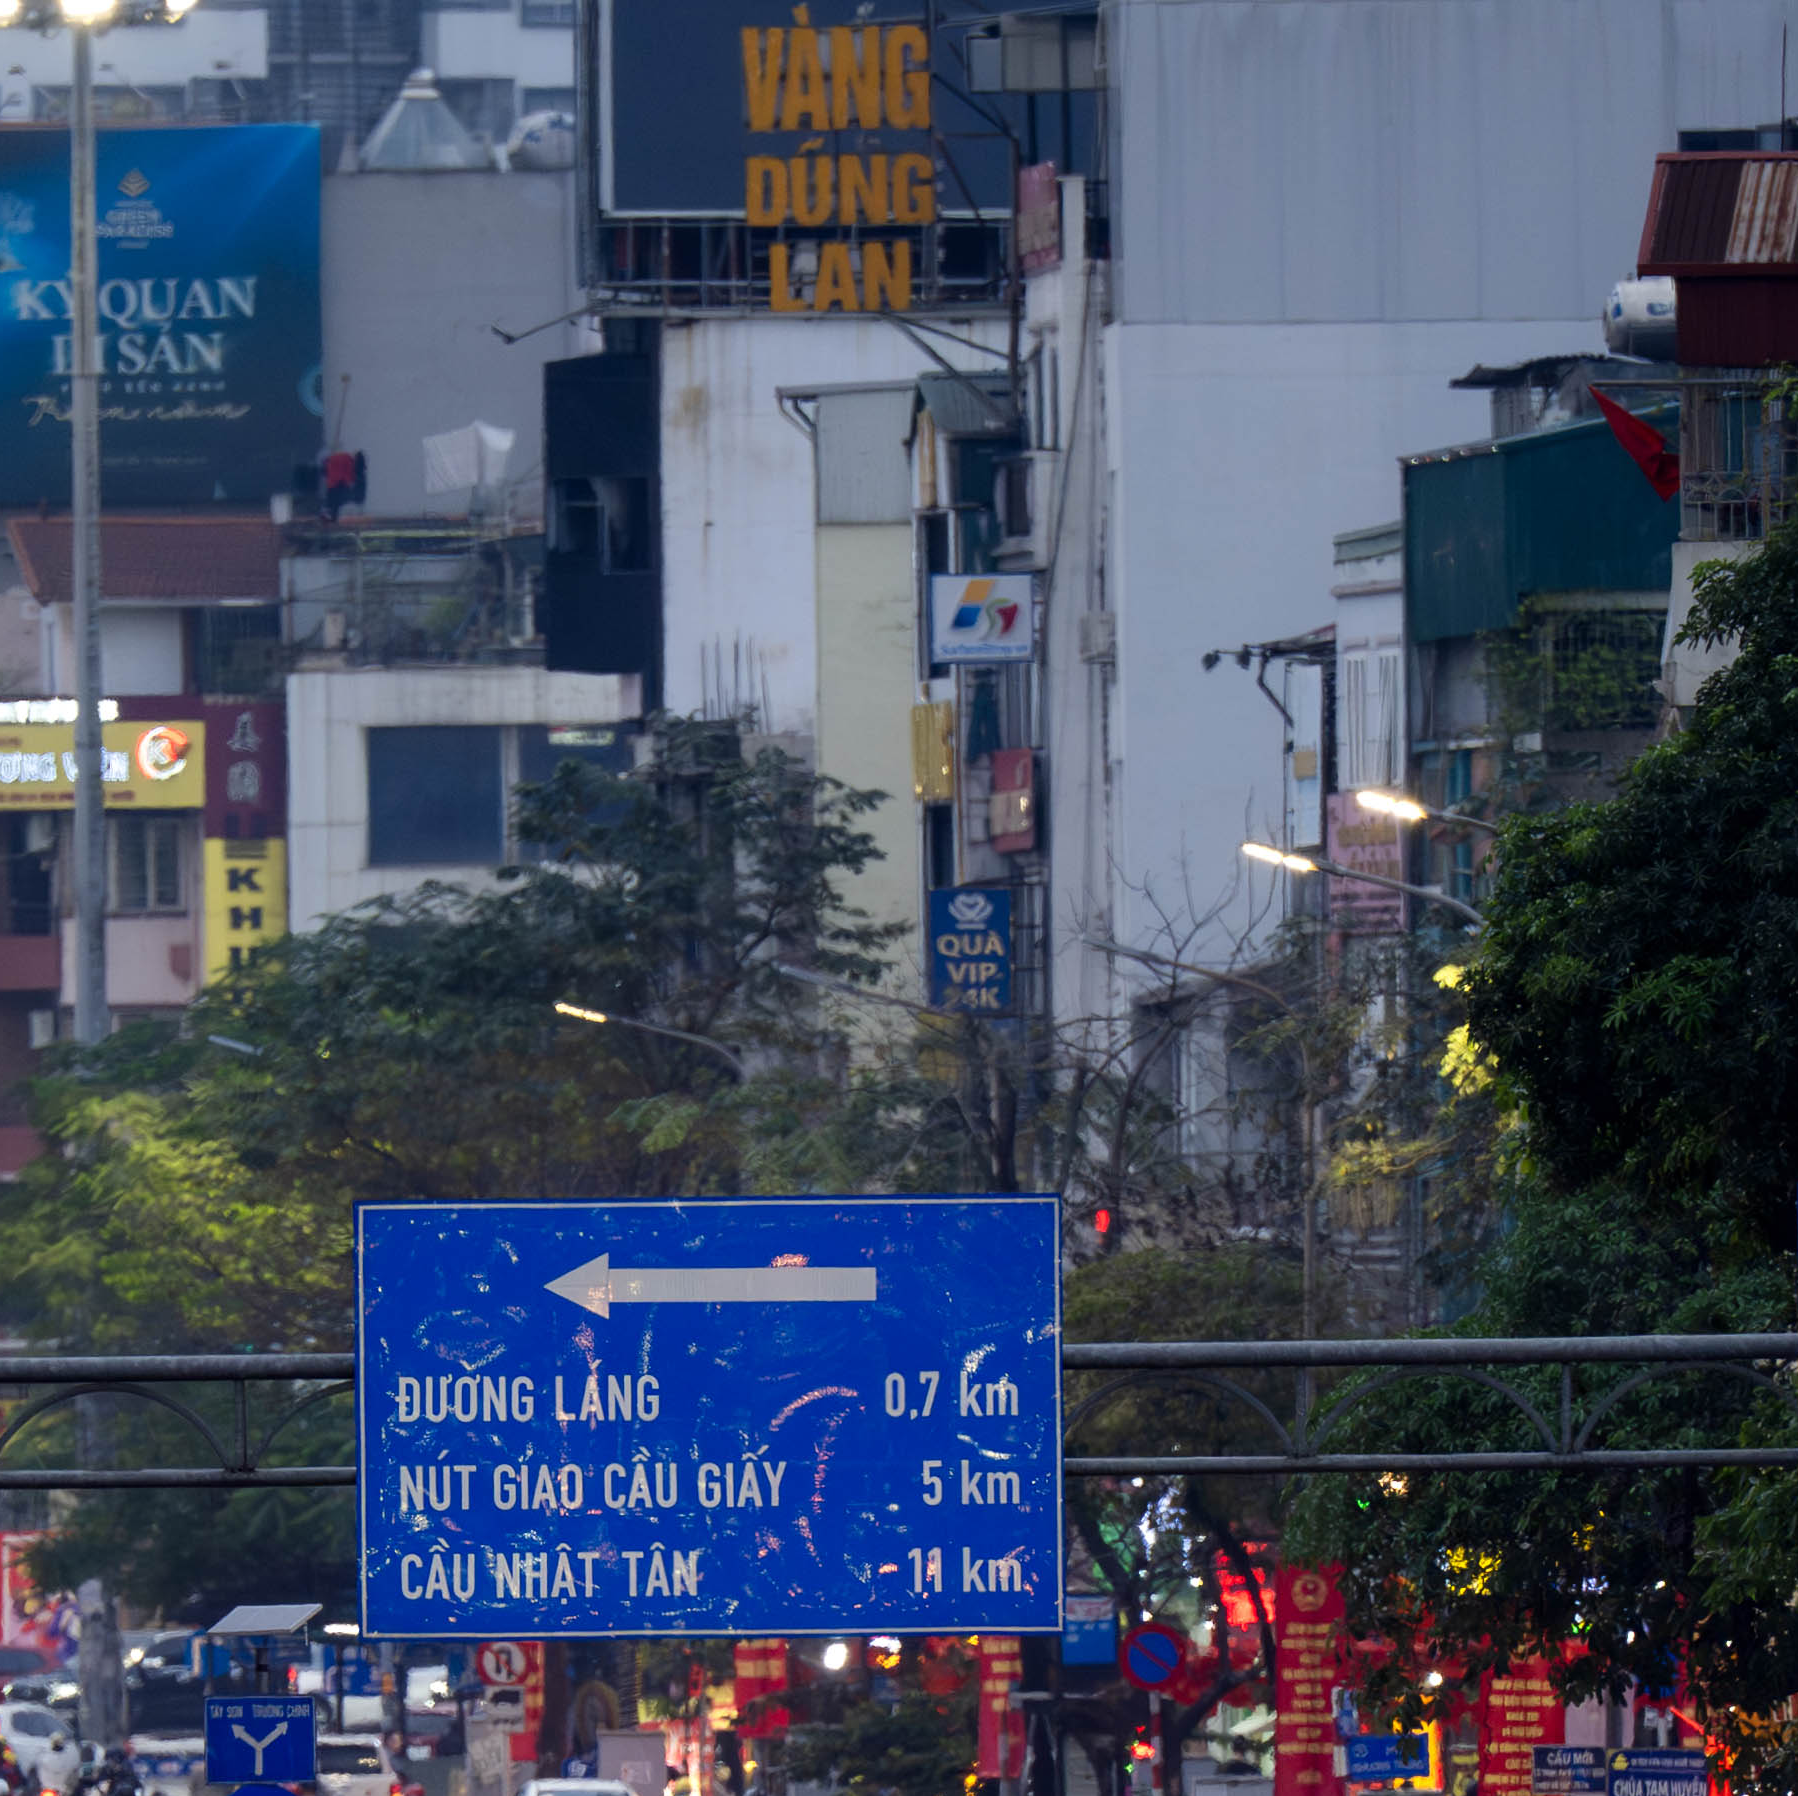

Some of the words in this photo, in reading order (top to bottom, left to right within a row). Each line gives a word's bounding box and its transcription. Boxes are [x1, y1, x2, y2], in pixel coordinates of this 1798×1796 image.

[742, 5, 931, 132] VÀNG
[97, 277, 259, 331] QUAN
[769, 241, 912, 312] LAN
[936, 930, 1005, 958] QUÀ
[946, 961, 1000, 985] VIP
[395, 1362, 535, 1423] ĐƯỜNG
[555, 1361, 661, 1422] LÁNG
[884, 1371, 941, 1421] 0,7
[959, 1372, 1020, 1417] km
[399, 1451, 476, 1512] NÚT
[493, 1463, 583, 1510] GIAO
[603, 1446, 677, 1508] CẦU
[697, 1444, 787, 1508] GIẤY
[921, 1459, 943, 1507] 5
[961, 1459, 1021, 1506] km
[400, 1537, 476, 1600] CẦU
[494, 1540, 600, 1605] NHẬT
[621, 1541, 701, 1597] TÂN
[907, 1547, 943, 1594] 11
[961, 1547, 1023, 1594] km
